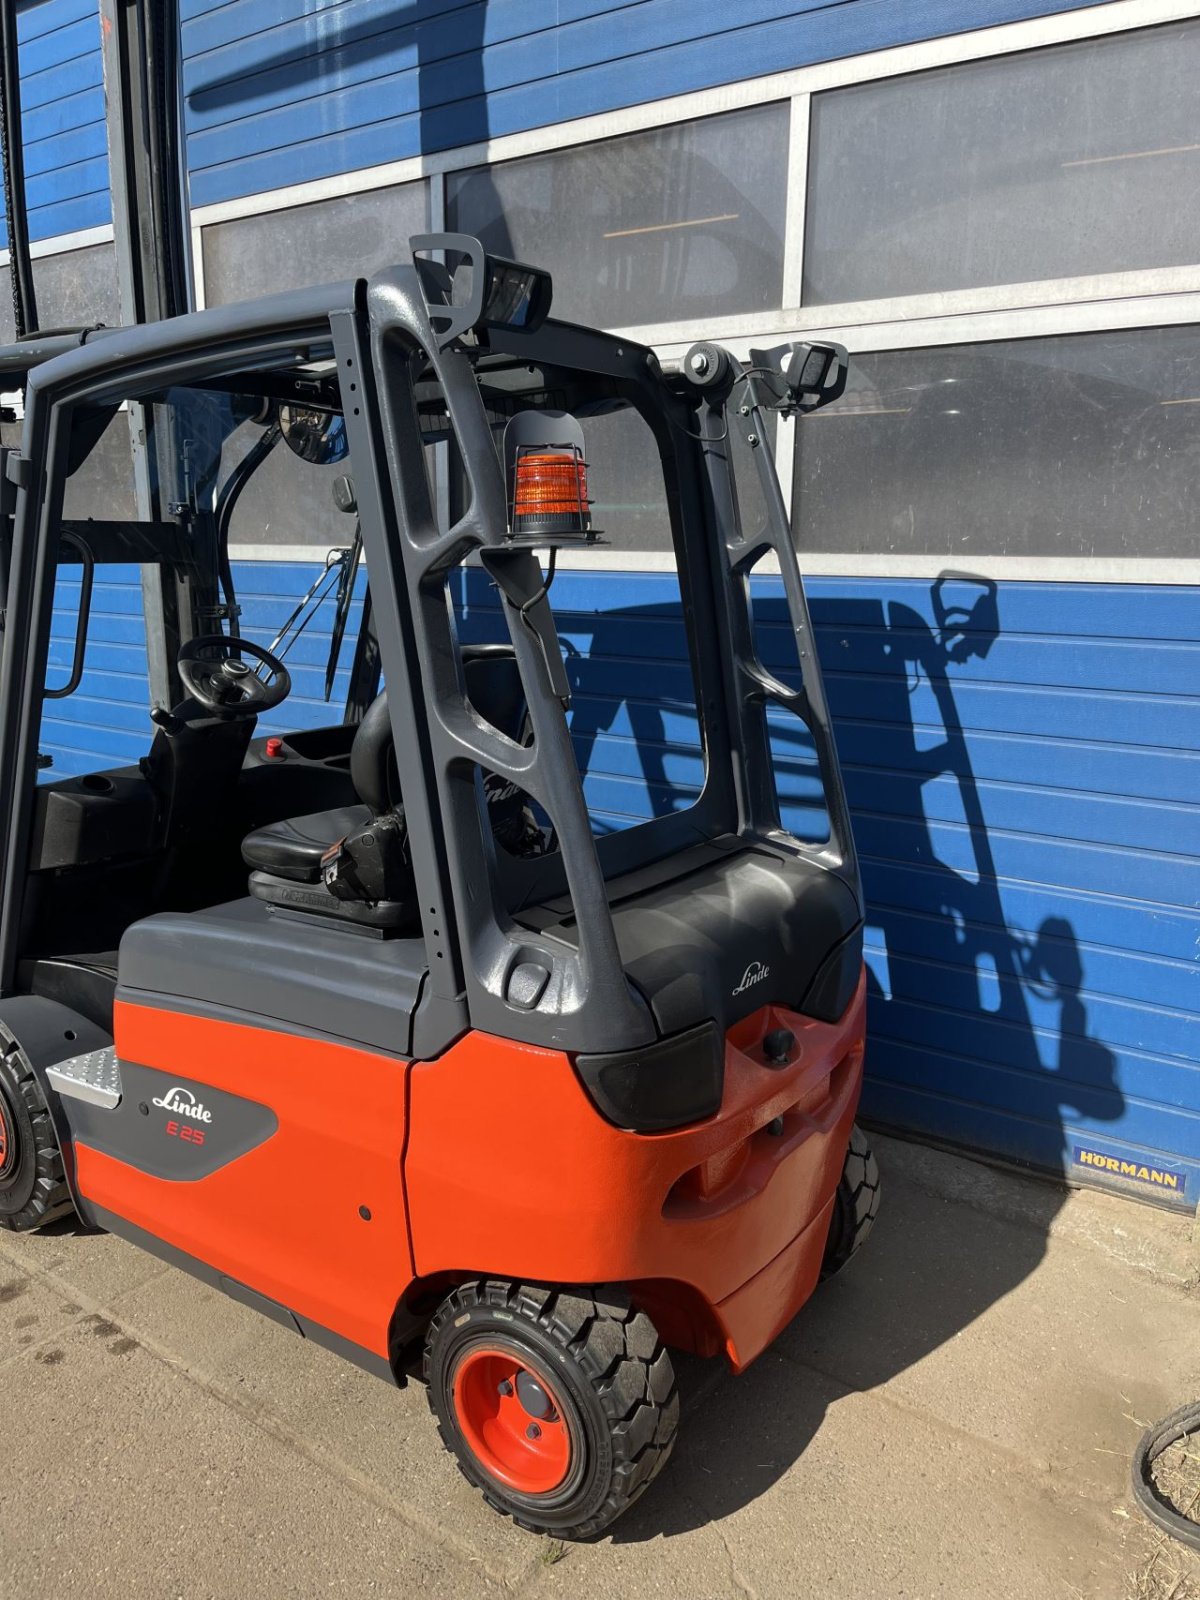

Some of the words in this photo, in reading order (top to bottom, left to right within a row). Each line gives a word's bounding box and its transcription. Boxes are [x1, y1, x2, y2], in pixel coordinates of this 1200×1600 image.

[732, 962, 769, 995] Linde
[152, 1087, 212, 1123] Linde
[166, 1120, 179, 1136] E
[180, 1125, 205, 1145] 25
[1080, 1150, 1177, 1187] HÖRMANN
